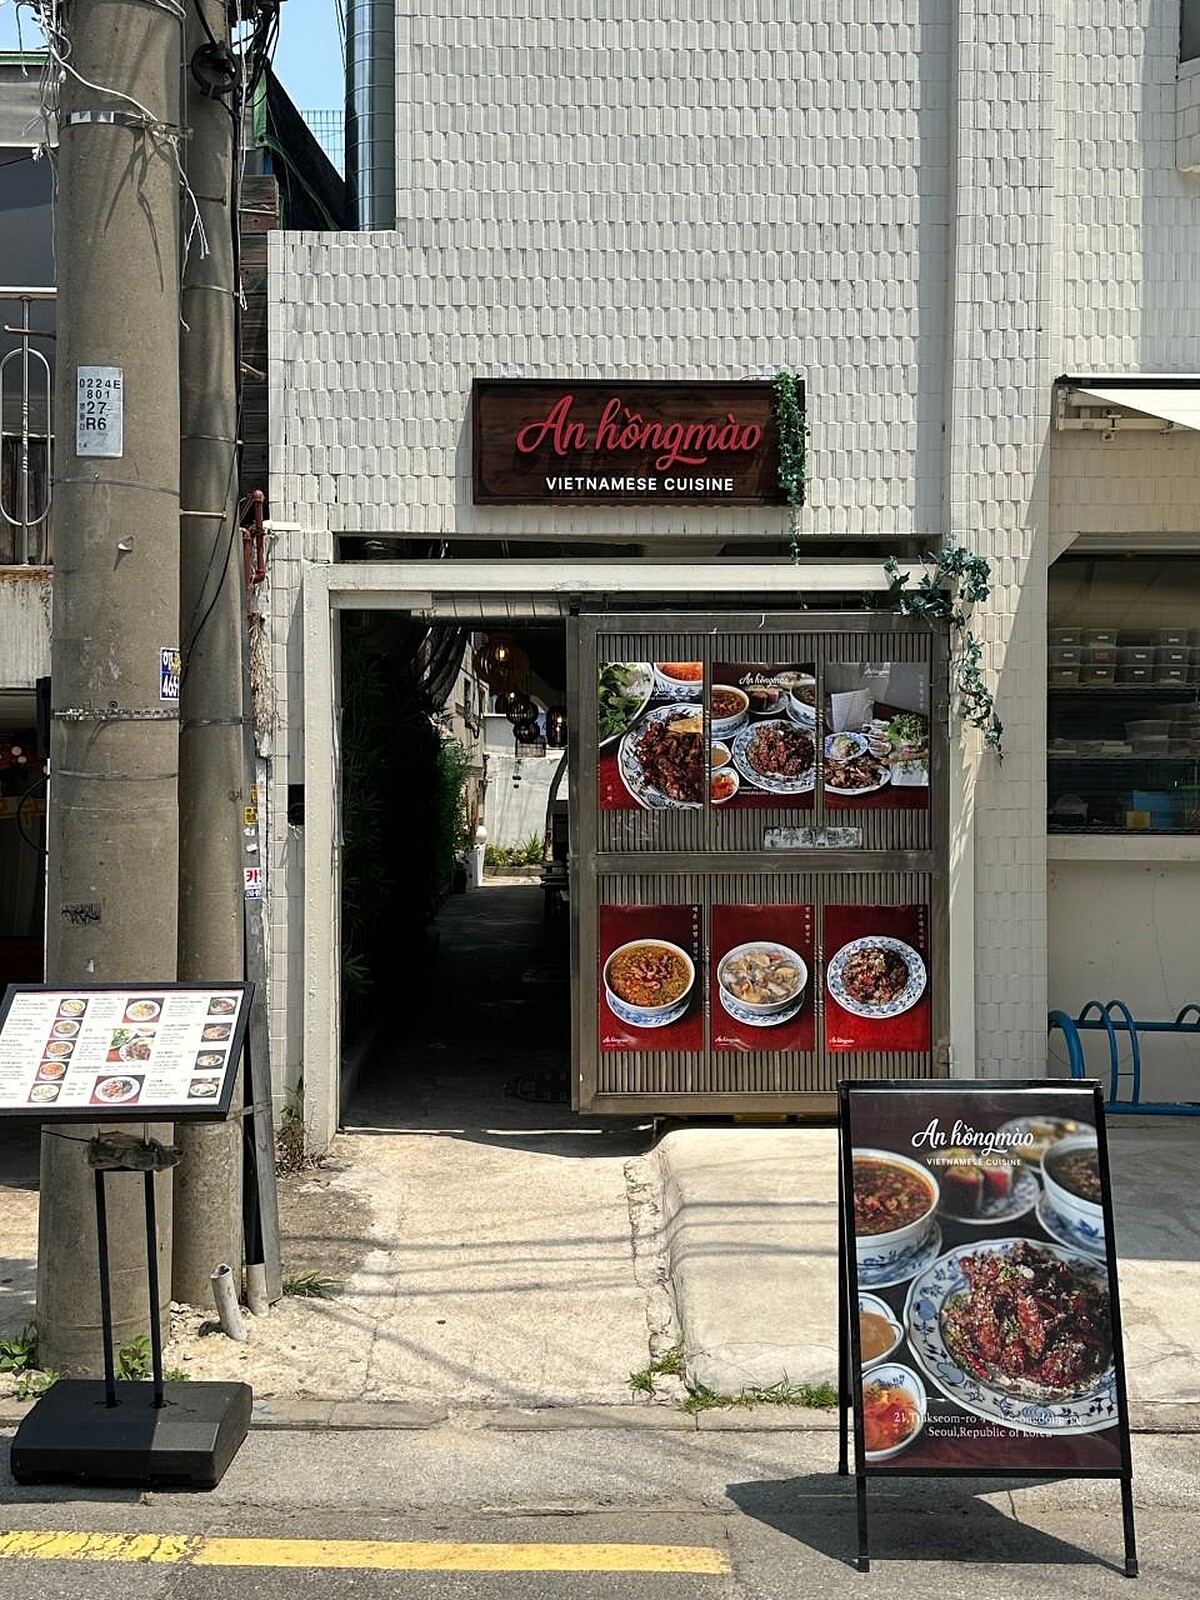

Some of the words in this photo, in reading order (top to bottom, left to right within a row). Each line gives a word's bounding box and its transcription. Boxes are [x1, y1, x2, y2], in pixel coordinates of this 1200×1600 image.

[79, 378, 121, 390] 0224E
[86, 389, 110, 400] 801
[85, 417, 107, 431] R6
[516, 395, 589, 456] An
[545, 477, 657, 491] VIETNAMESE
[664, 477, 734, 491] CUISINE
[911, 1118, 948, 1149] An
[926, 1158, 983, 1167] VIETNAMESE
[984, 1158, 1021, 1167] CUISINE
[928, 1425, 1006, 1439] Seoul,Republic
